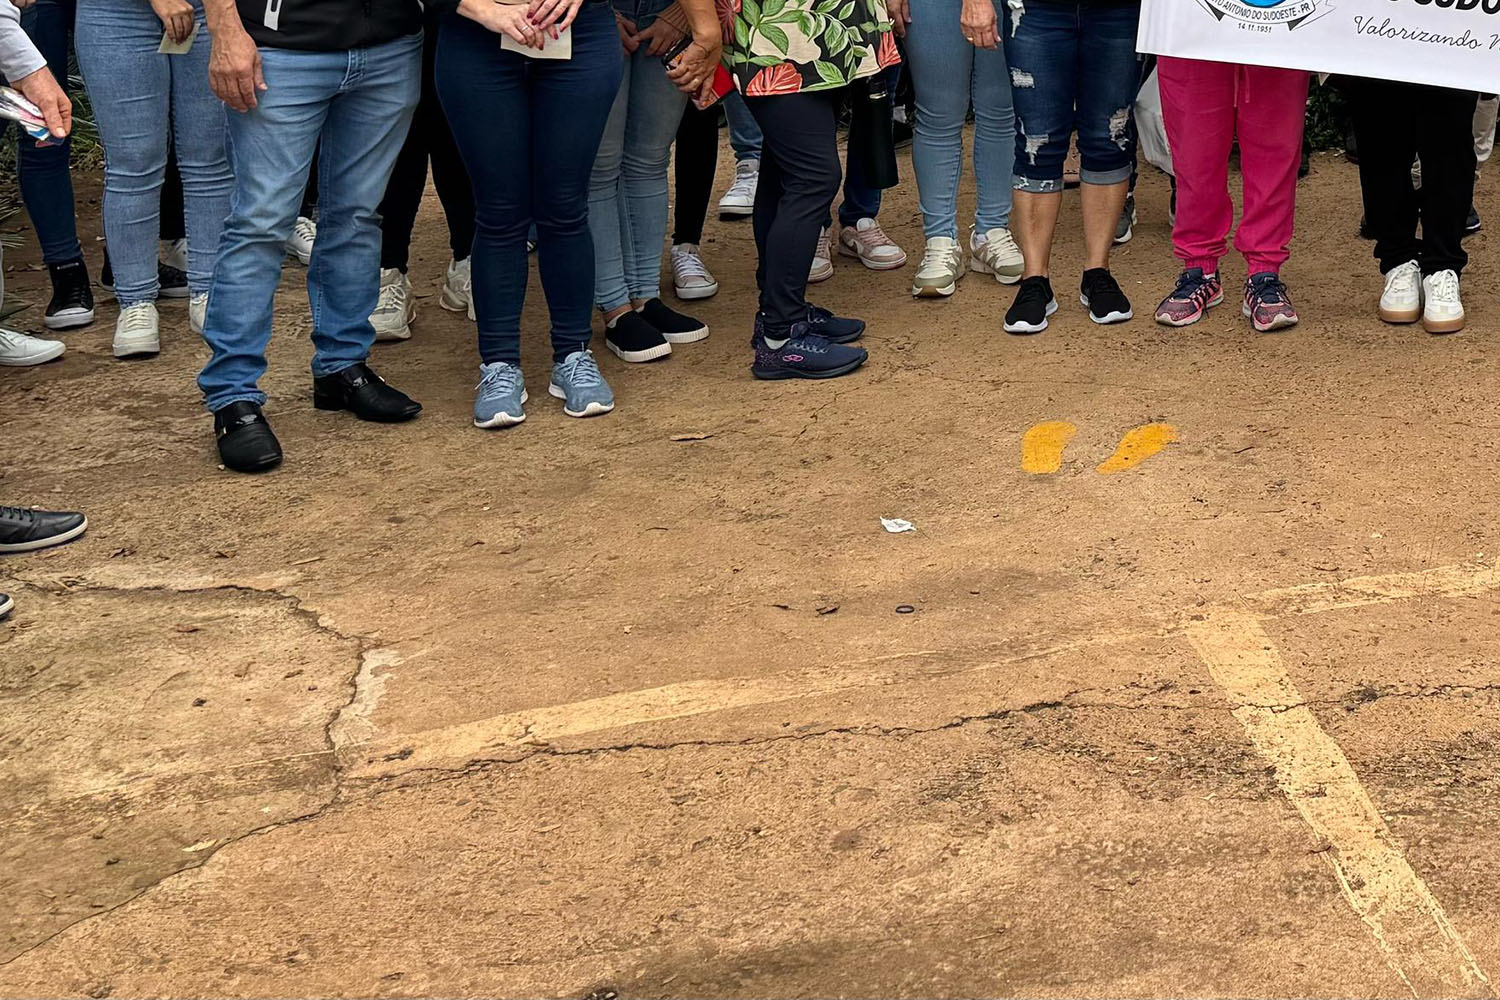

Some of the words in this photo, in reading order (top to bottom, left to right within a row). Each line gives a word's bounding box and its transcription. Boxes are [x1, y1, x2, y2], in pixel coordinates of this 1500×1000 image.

[1223, 1, 1251, 19] ANTONIO
[1252, 10, 1262, 20] DO
[1263, 8, 1297, 21] SUDOESTE
[1300, 2, 1311, 14] PR
[1354, 15, 1483, 49] Valorizando
